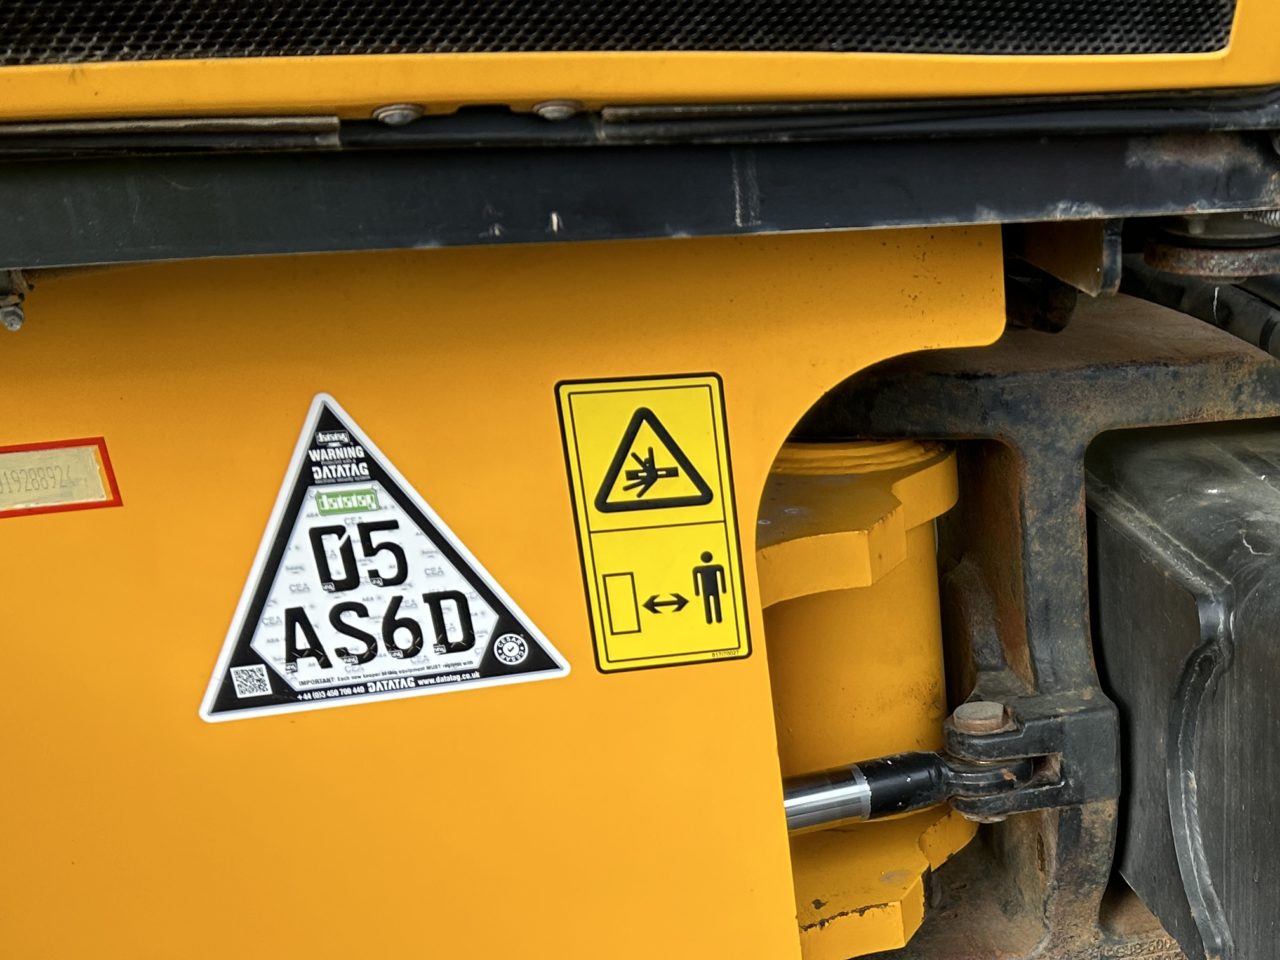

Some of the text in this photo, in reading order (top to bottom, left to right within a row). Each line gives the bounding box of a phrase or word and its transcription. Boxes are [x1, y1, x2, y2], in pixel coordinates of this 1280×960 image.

[309, 446, 364, 461] WARNING
[311, 463, 369, 479] DATATAG
[284, 590, 476, 672] AS6D
[366, 676, 416, 693] DATATAG
[417, 671, 481, 686] www.datatag.co.uk
